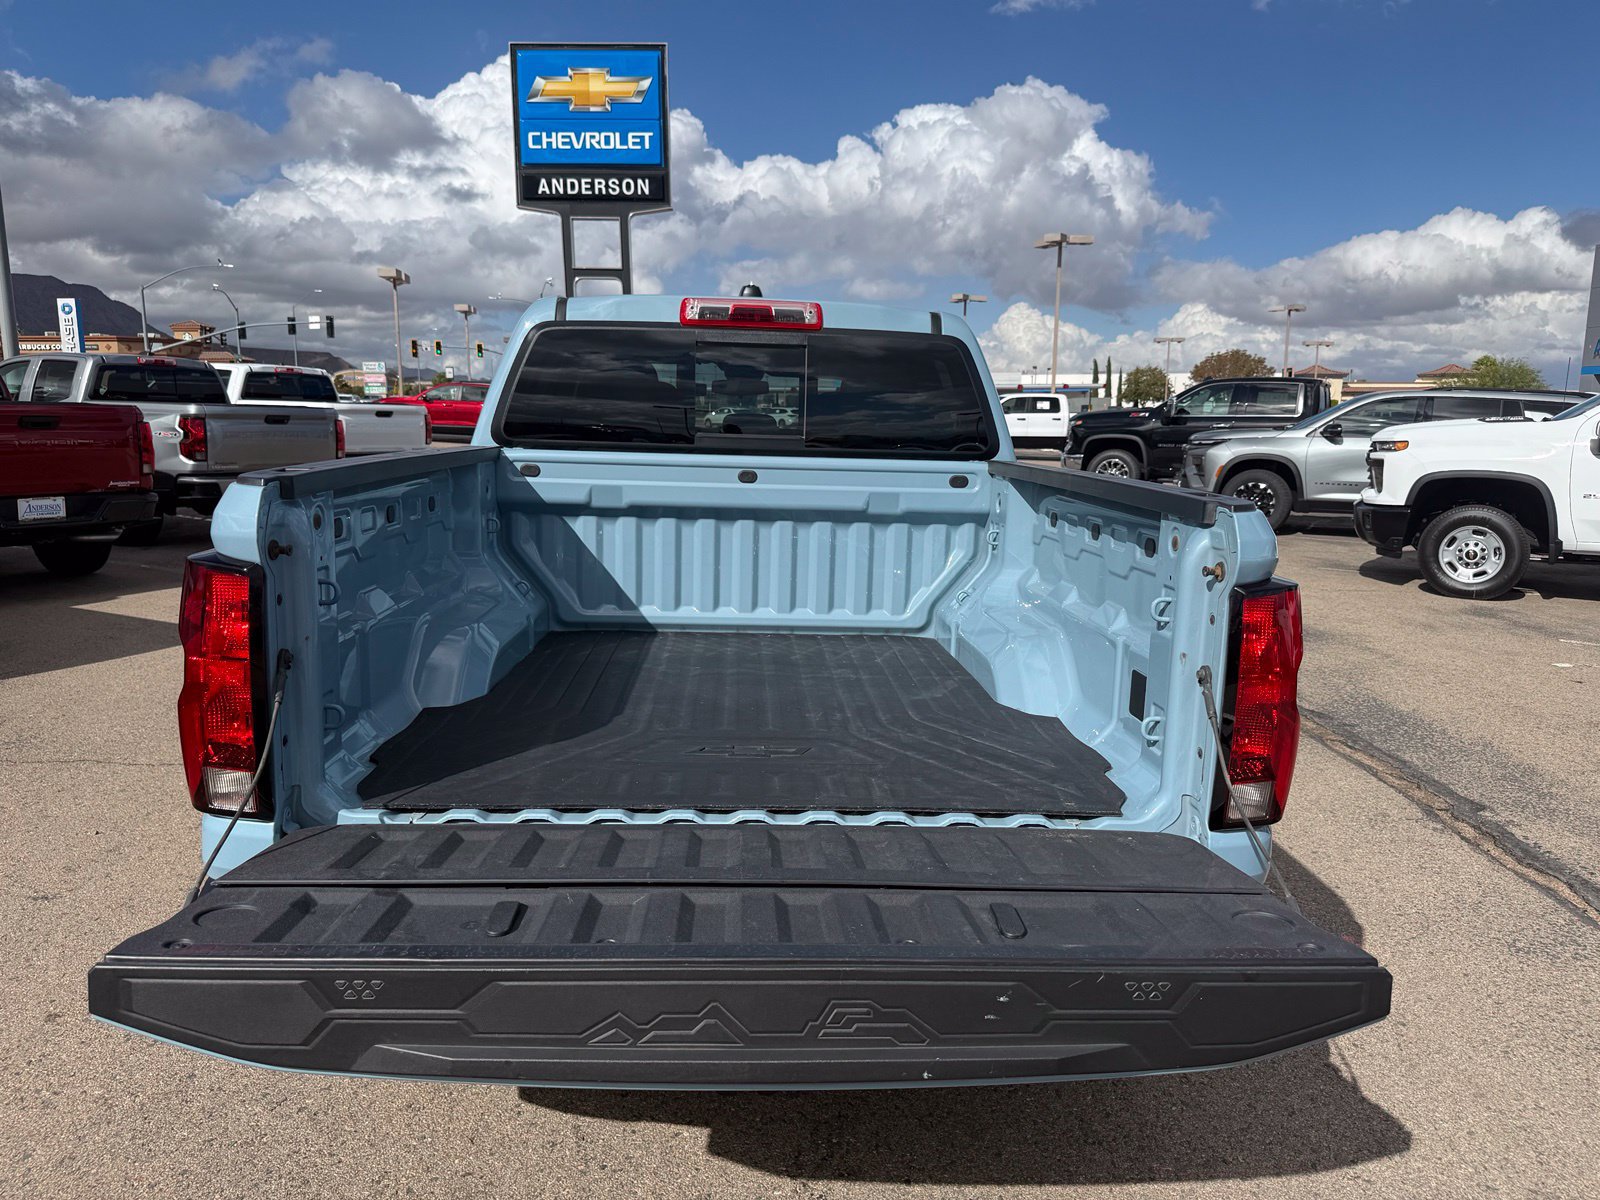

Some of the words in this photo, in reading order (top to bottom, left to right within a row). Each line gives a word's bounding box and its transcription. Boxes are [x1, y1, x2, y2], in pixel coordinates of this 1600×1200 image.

[528, 132, 653, 150] CHEVROLET
[538, 178, 650, 196] ANDERSON
[64, 317, 76, 352] HASE
[22, 503, 61, 517] ANDERSON
